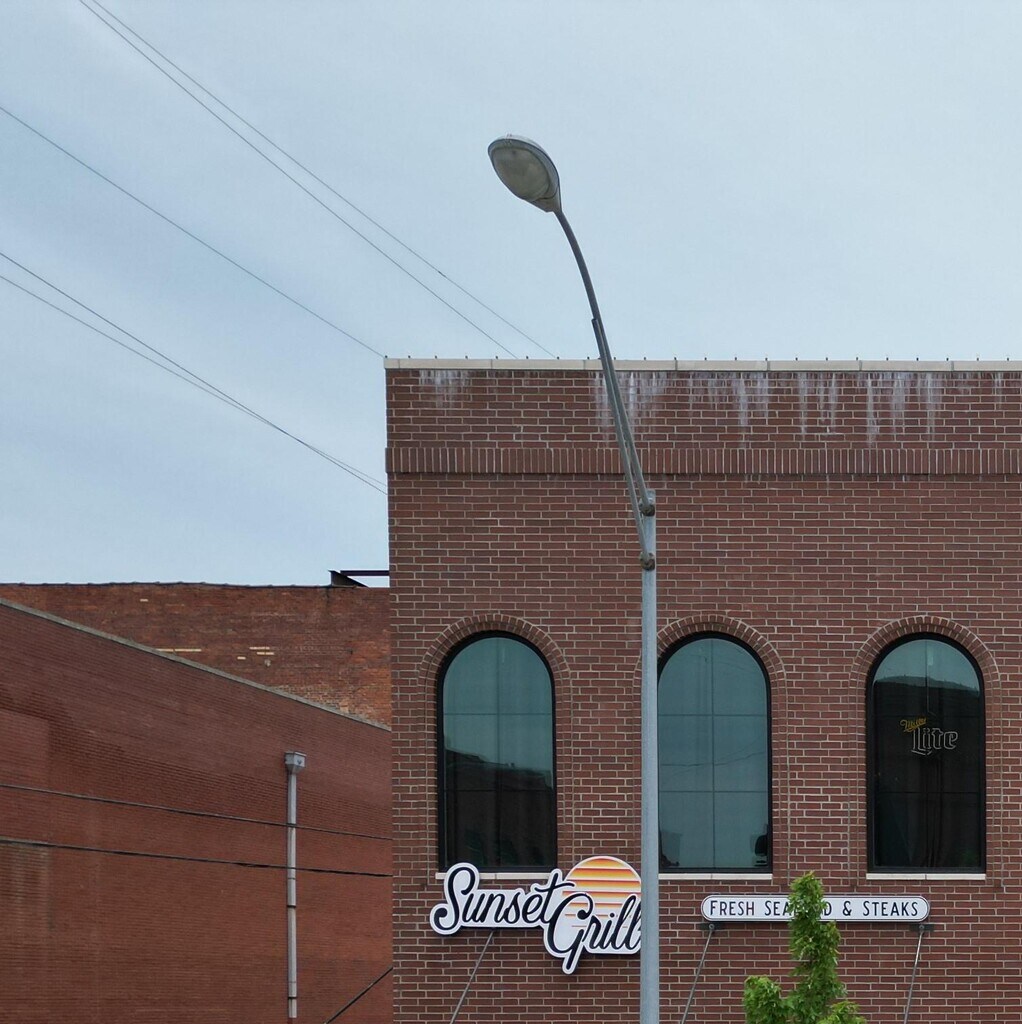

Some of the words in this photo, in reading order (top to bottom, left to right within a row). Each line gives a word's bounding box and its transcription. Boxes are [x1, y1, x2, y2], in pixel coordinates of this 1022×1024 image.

[911, 727, 958, 755] Lite
[434, 867, 575, 930] Sunset
[710, 900, 755, 916] FRESH
[764, 900, 832, 916] SEAD
[842, 900, 852, 916] &
[863, 900, 918, 917] STEAKS
